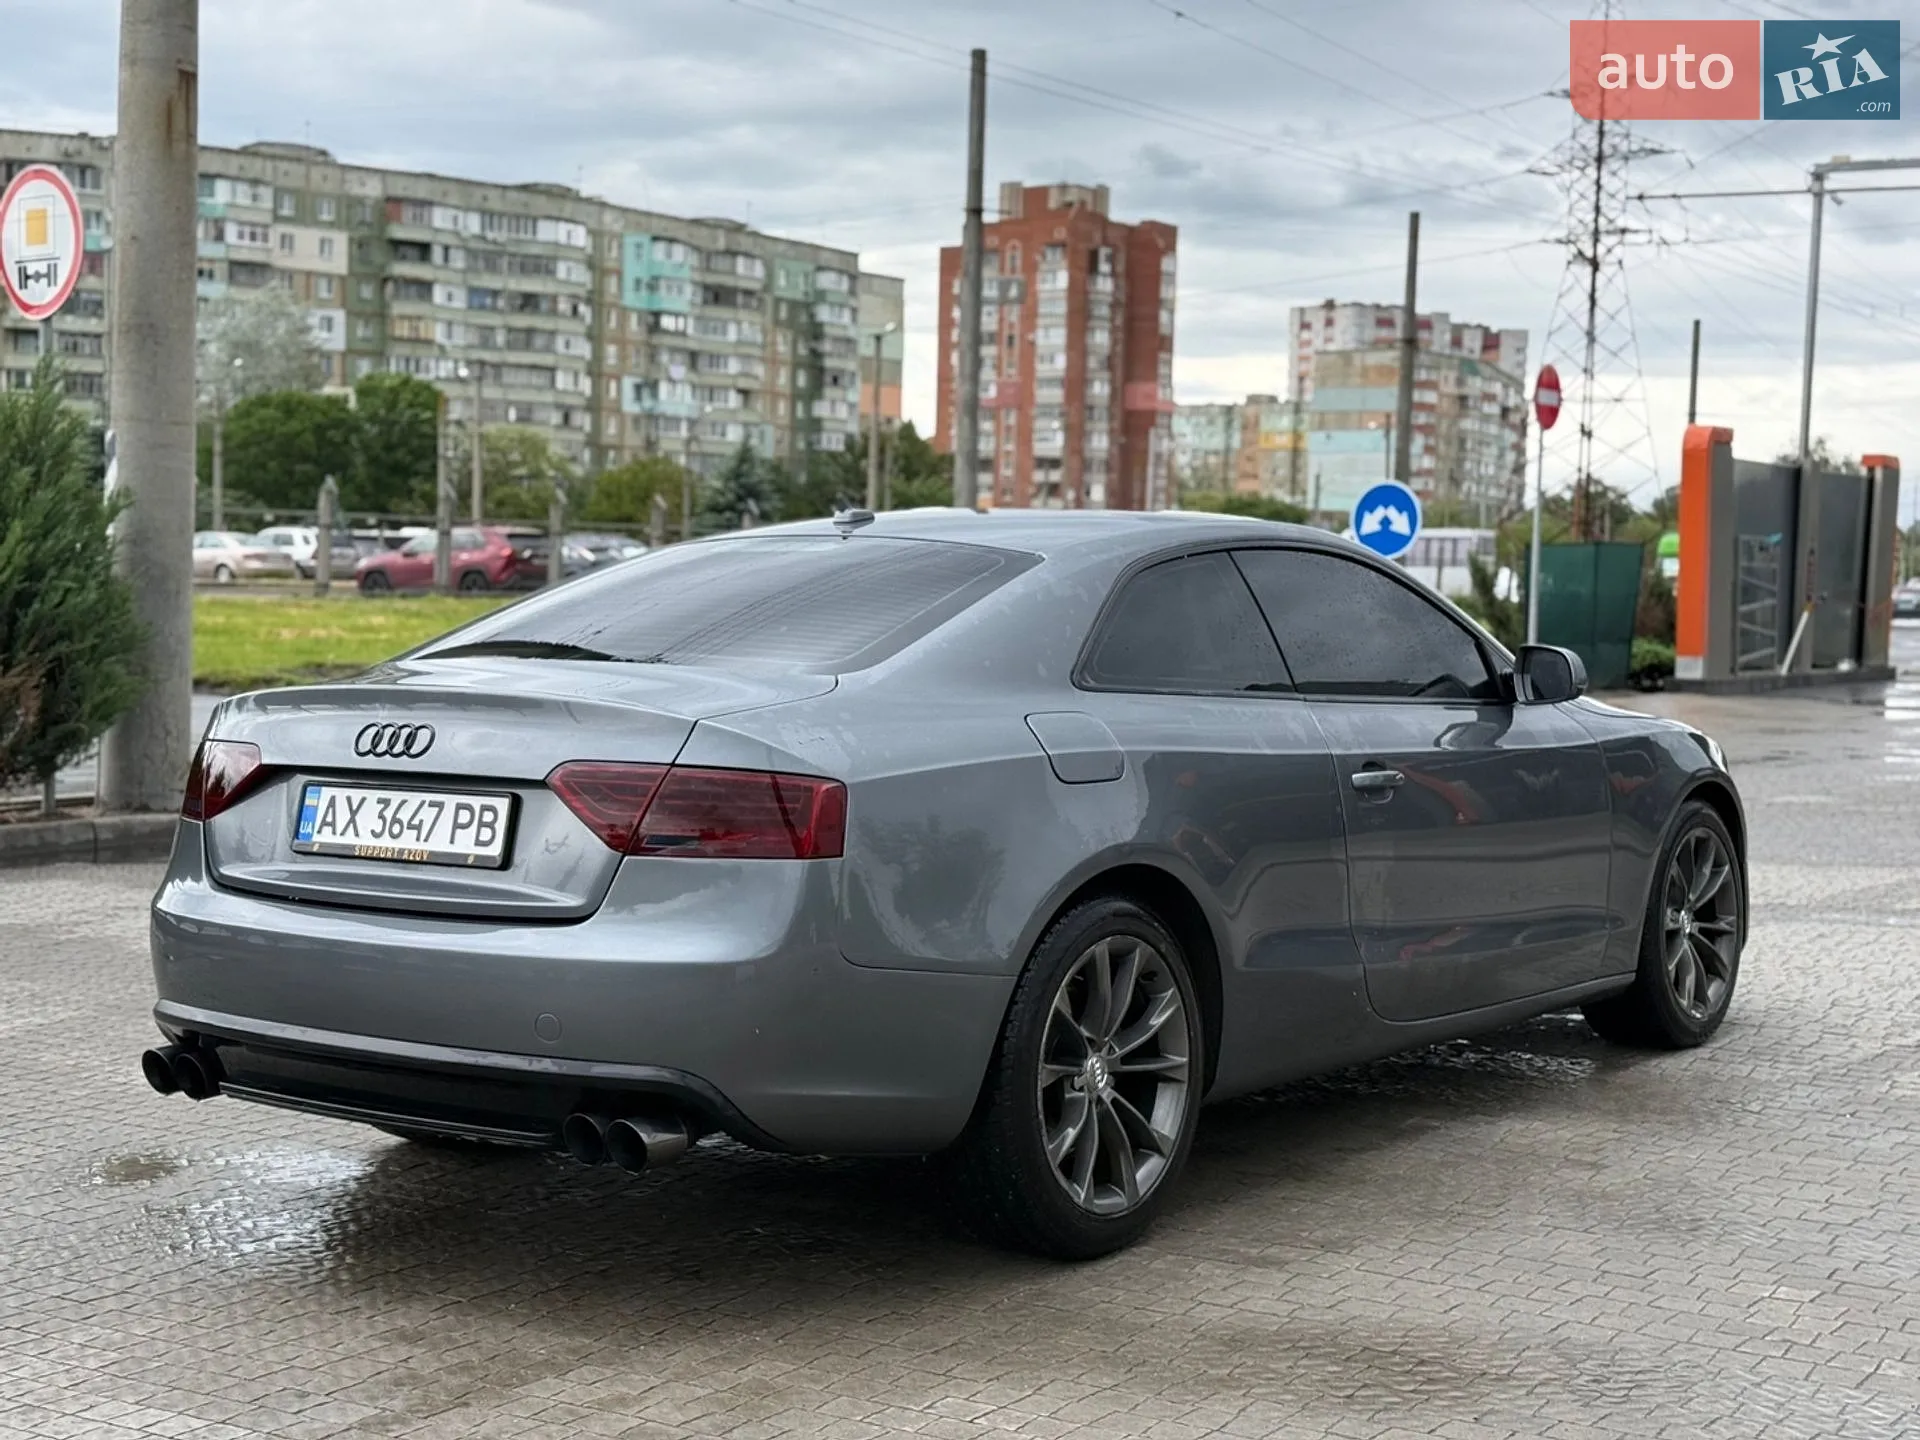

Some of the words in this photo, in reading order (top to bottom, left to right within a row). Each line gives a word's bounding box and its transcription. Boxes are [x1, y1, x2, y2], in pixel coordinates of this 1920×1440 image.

[299, 821, 313, 834] UA
[316, 794, 368, 838] AX
[370, 797, 445, 843] 3647
[449, 802, 499, 847] PB
[354, 844, 399, 858] SUPPORT
[402, 847, 430, 861] AZOV
